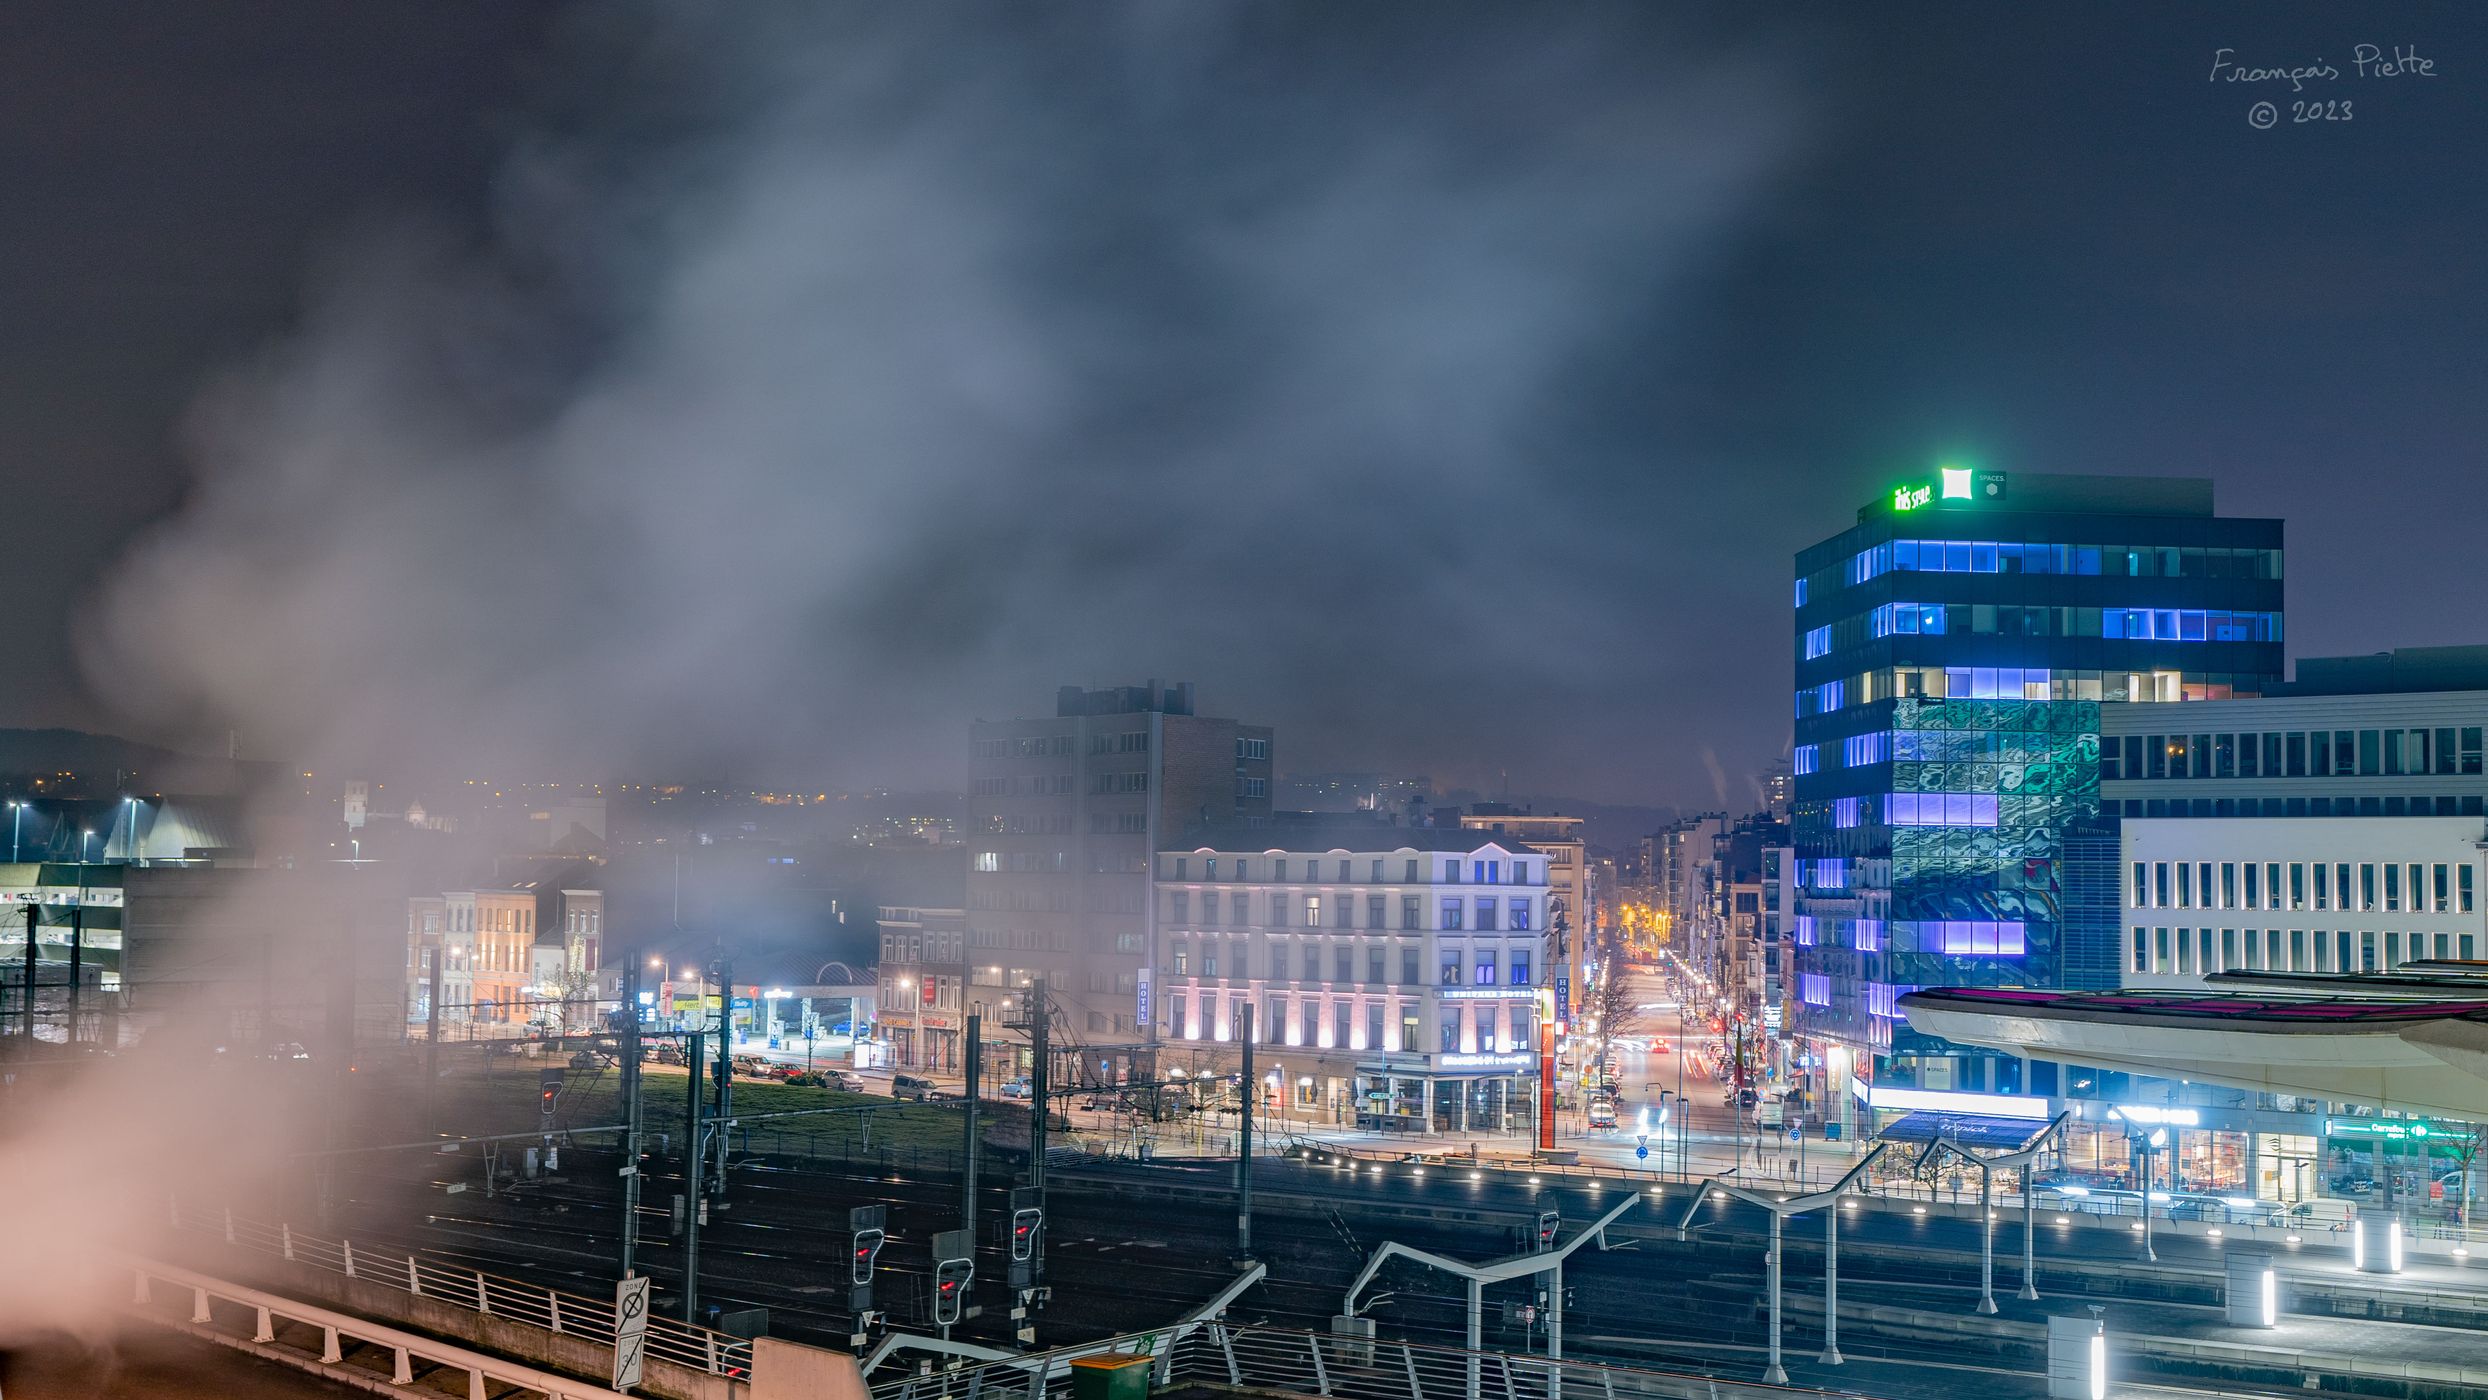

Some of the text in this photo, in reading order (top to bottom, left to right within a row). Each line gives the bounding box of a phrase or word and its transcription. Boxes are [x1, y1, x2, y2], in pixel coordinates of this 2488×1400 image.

[1559, 979, 1567, 1018] HOTEL
[625, 1281, 642, 1291] ZONE
[622, 1352, 638, 1368] 30
